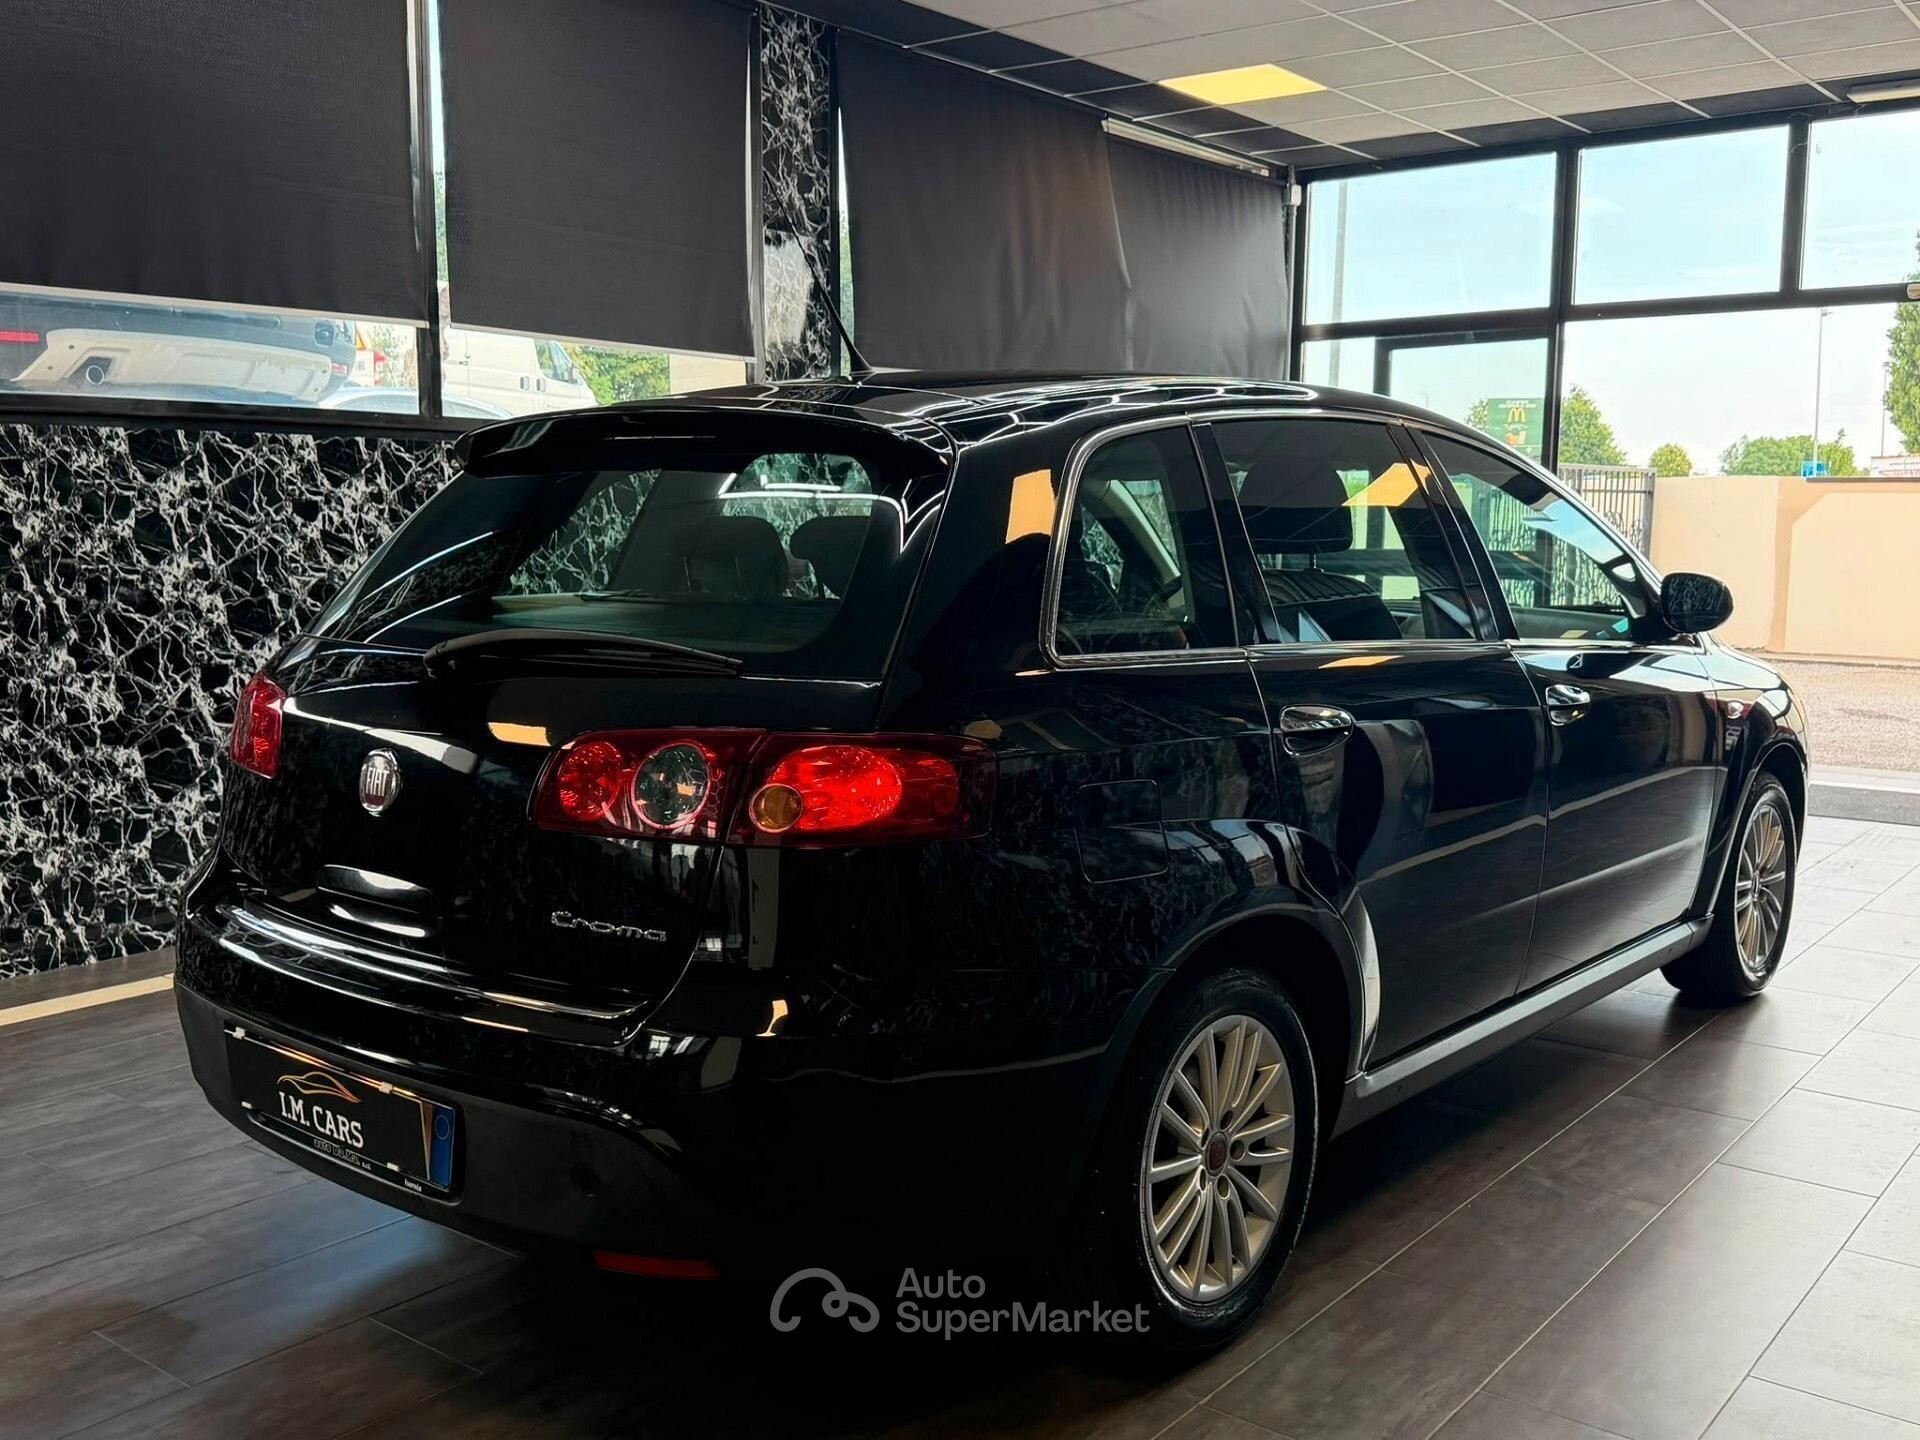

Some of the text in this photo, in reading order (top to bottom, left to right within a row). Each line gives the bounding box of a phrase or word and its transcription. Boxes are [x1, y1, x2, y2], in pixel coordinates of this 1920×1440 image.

[365, 767, 390, 797] FIAT
[551, 911, 666, 942] Croma
[279, 1091, 364, 1148] I.M. CARS
